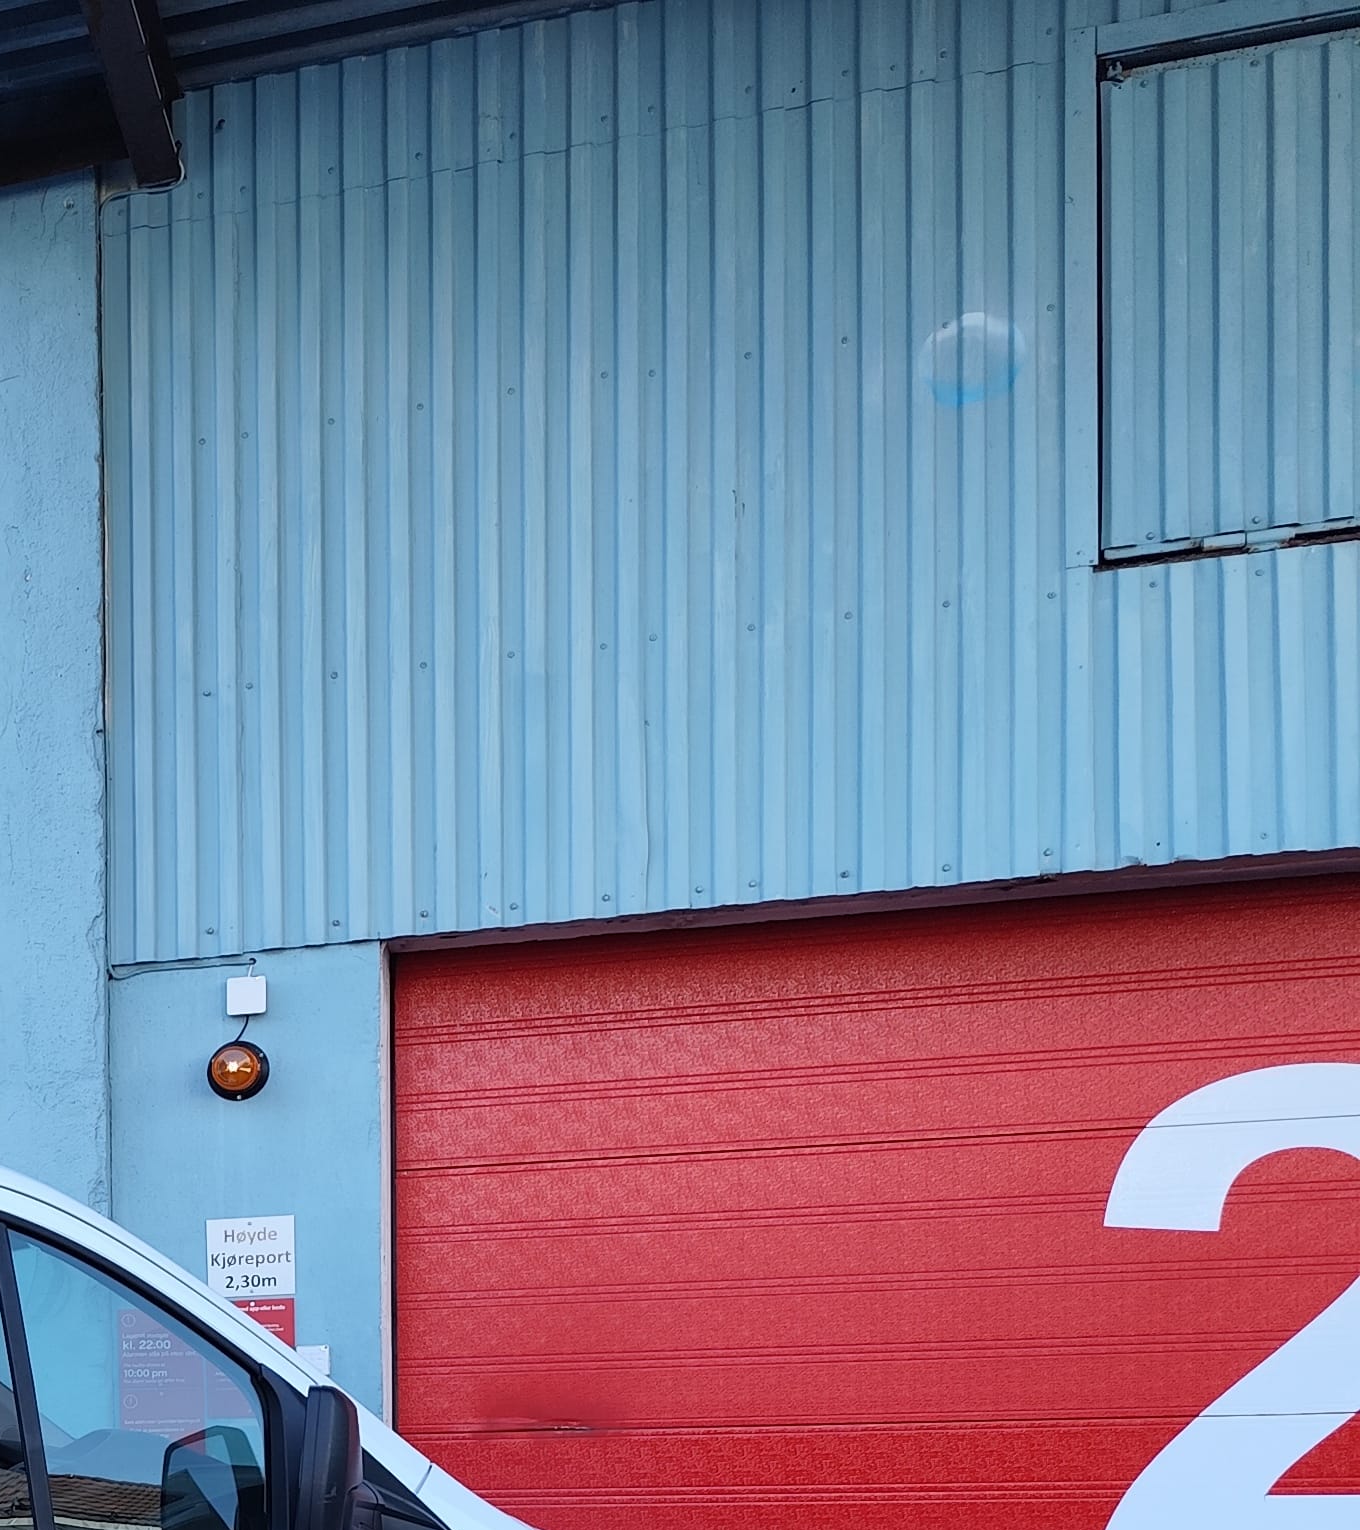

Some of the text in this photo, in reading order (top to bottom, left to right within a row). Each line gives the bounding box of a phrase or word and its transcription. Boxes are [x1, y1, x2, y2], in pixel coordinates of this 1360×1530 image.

[224, 1226, 278, 1245] Høyde
[210, 1250, 292, 1269] Kjøreport
[225, 1274, 277, 1291] 2,30m
